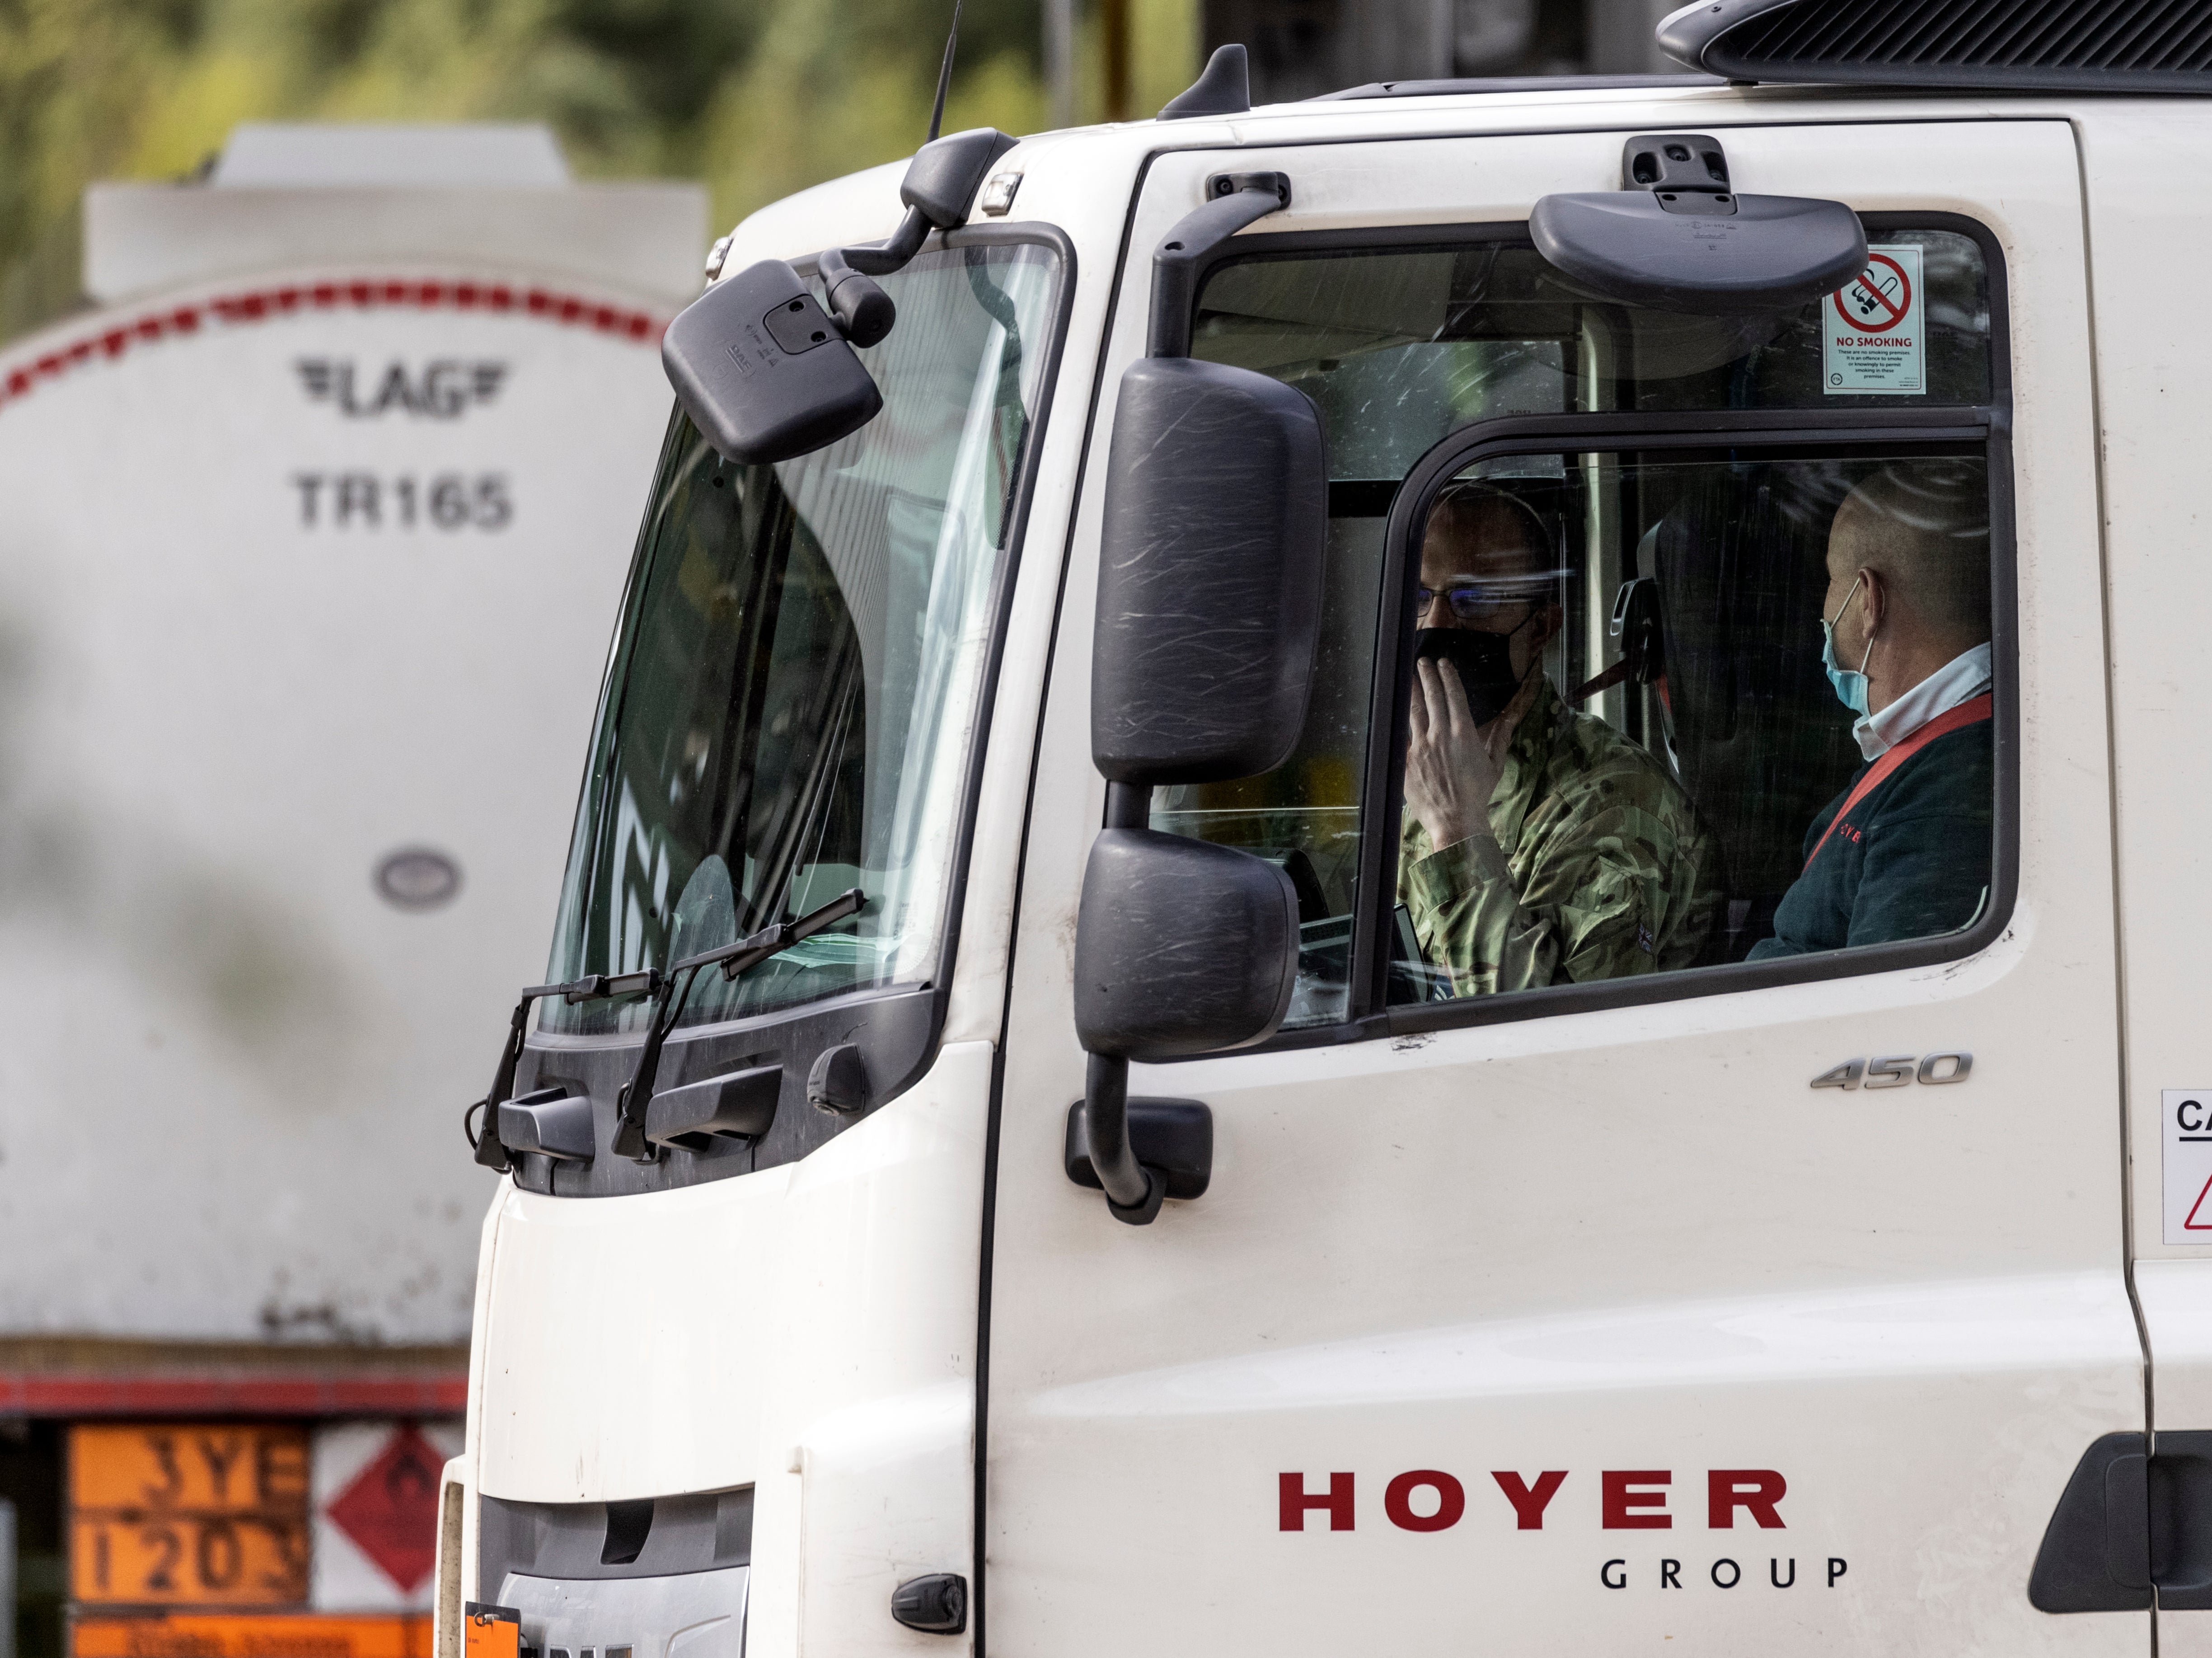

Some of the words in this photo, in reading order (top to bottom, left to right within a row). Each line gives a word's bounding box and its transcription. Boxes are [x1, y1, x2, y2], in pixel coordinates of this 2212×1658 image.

[1837, 337, 1854, 346] NO
[1857, 338, 1912, 347] SMOKING
[337, 359, 469, 418] LAG
[294, 471, 512, 531] TR165
[1810, 1051, 1973, 1090] 450
[1279, 1470, 1787, 1532] HOYER
[1601, 1558, 1848, 1589] GROUP
